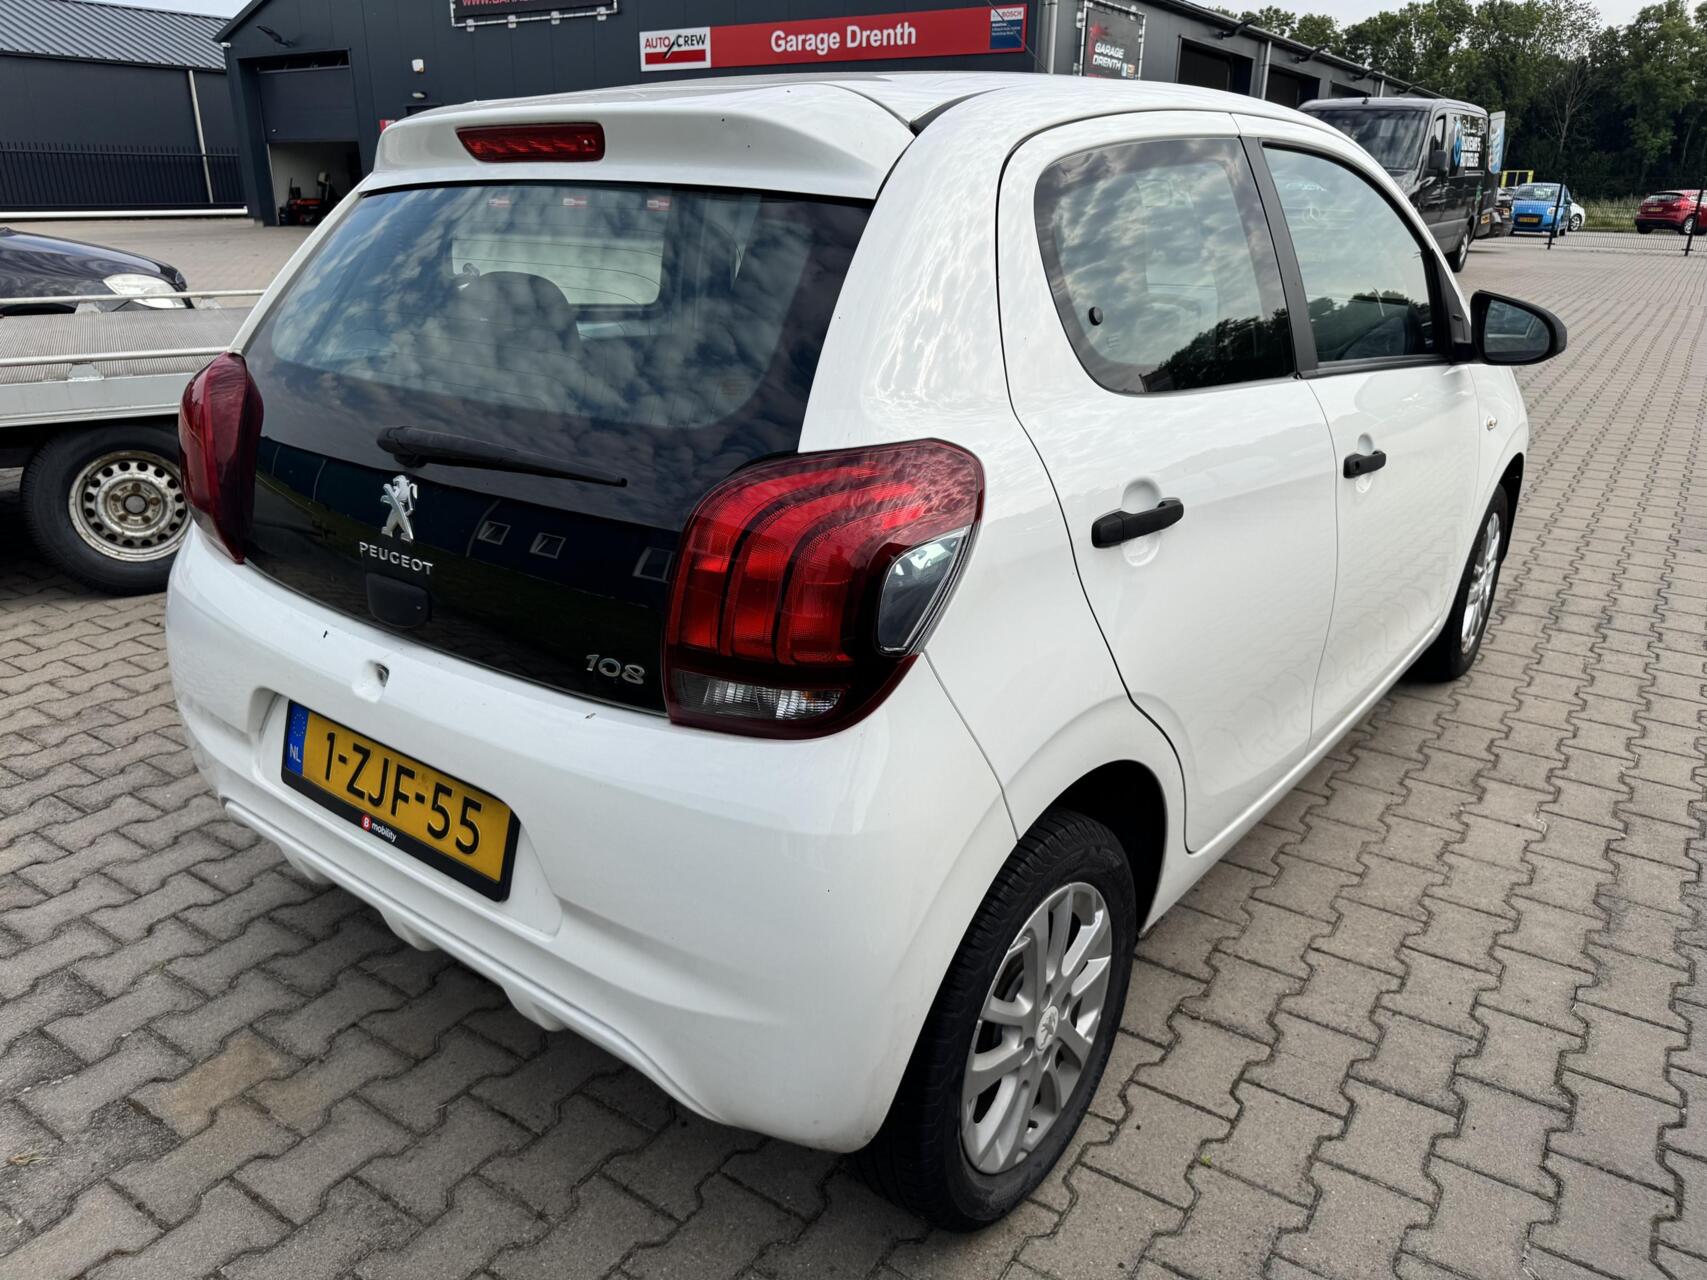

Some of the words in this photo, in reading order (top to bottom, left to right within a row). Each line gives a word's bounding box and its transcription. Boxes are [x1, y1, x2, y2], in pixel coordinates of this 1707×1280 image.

[644, 36, 671, 49] AUTO
[675, 33, 706, 48] CREW
[770, 29, 841, 56] Garage
[846, 21, 917, 48] Drenth
[1094, 41, 1125, 59] GARAGE
[1092, 54, 1122, 71] DRENTH
[359, 541, 434, 576] PEUGEOT
[585, 653, 646, 685] 108
[289, 743, 302, 764] NL
[324, 731, 483, 855] 1-ZJF-55
[371, 822, 397, 843] mobility
